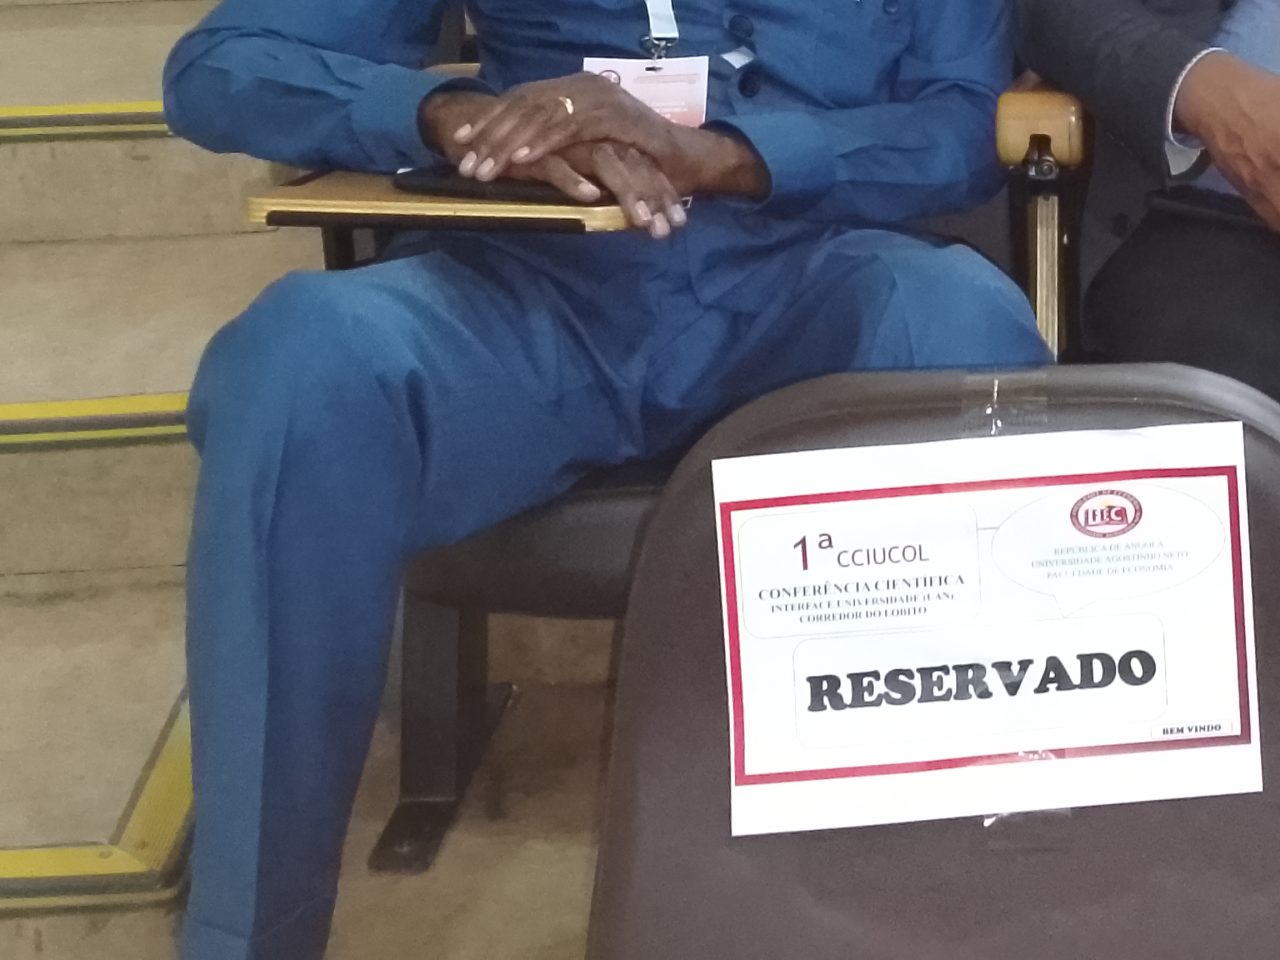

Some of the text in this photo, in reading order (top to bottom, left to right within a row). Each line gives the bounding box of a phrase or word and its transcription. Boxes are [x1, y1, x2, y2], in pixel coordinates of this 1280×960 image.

[836, 544, 930, 568] CCIUCOL
[758, 572, 965, 600] CONFERÊNCIA CIENTÍFICA
[799, 610, 862, 624] CORREDOR
[865, 610, 882, 620] DO
[806, 649, 1156, 713] RESERVADO
[1162, 722, 1222, 736] BEM VINDO
